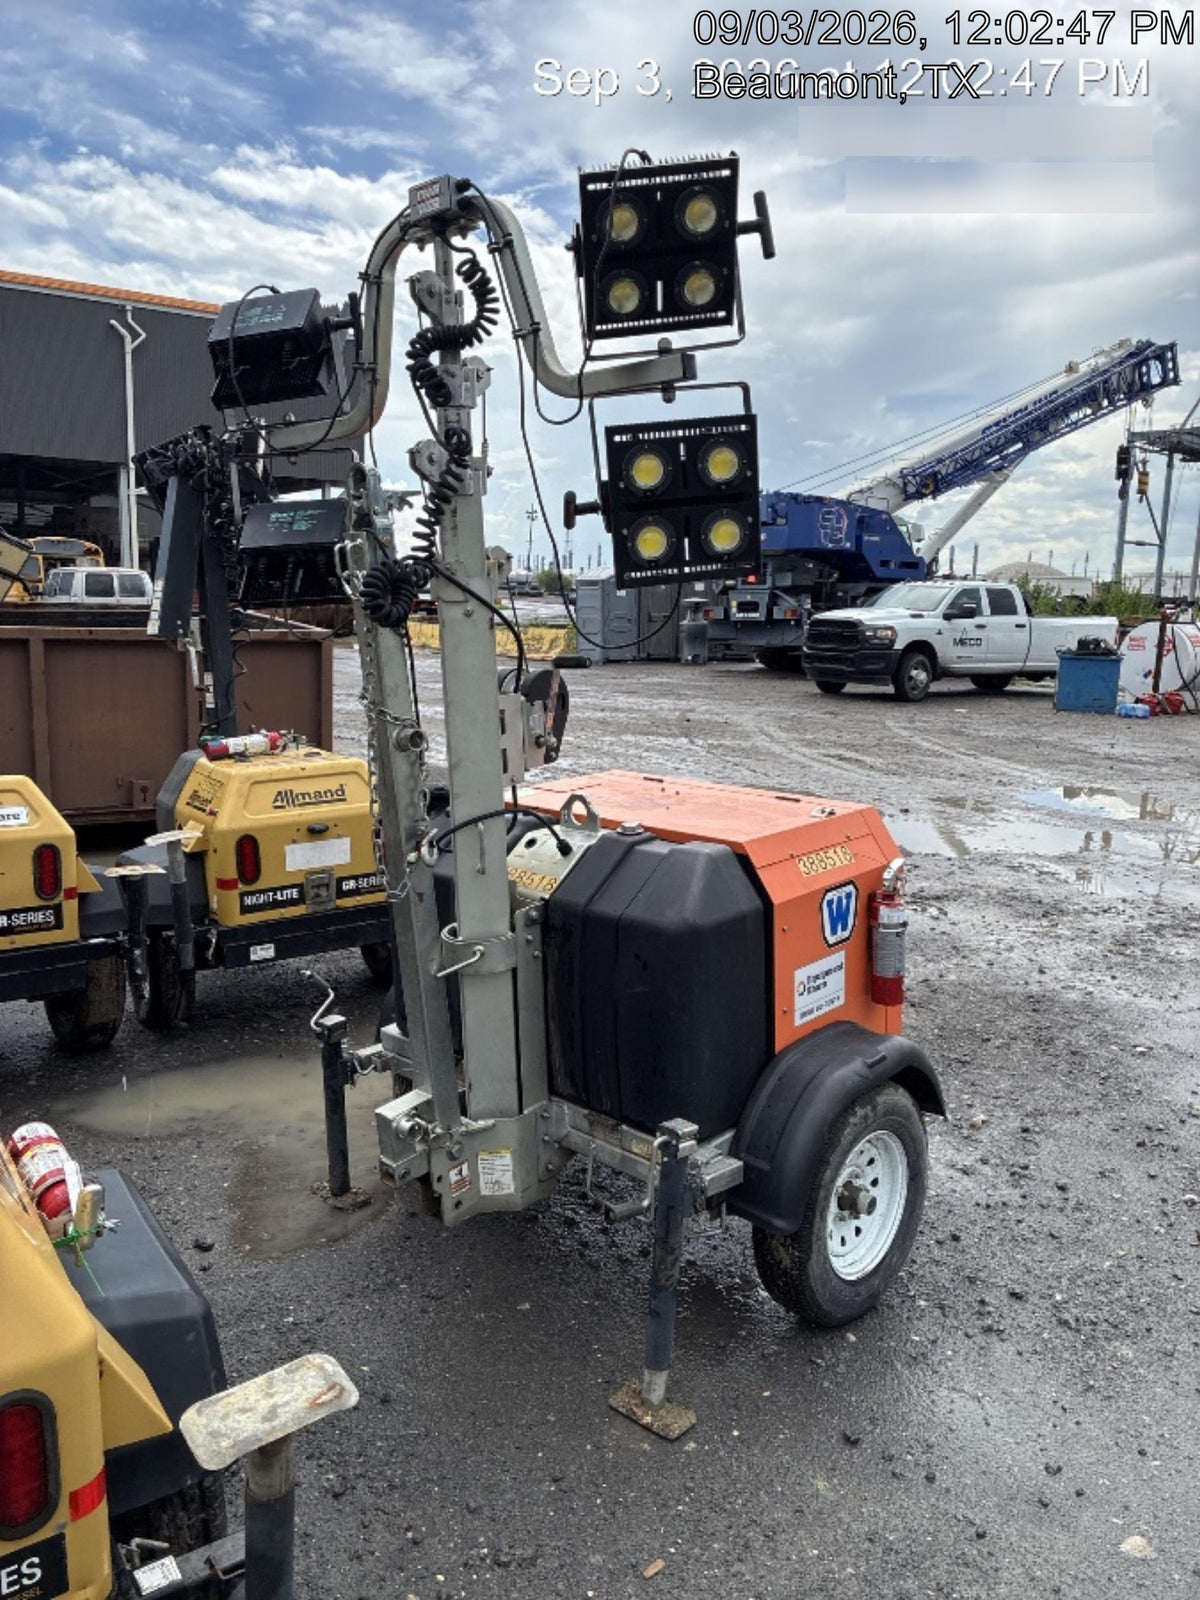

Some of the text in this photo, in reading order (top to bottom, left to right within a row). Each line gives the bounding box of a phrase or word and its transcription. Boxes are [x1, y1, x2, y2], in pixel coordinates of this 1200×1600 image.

[272, 784, 347, 808] Allmand
[798, 845, 853, 875] 388518
[826, 891, 853, 937] W
[1, 1556, 42, 1596] ES
